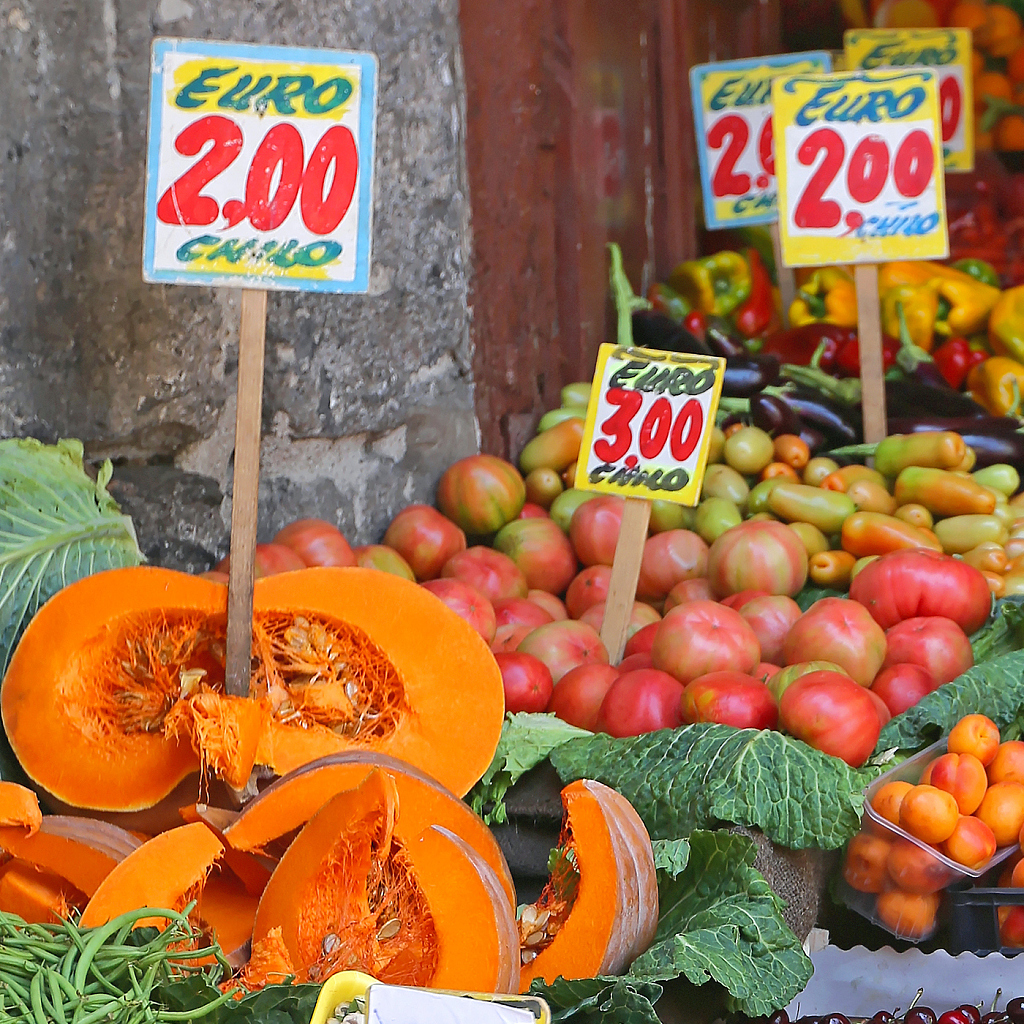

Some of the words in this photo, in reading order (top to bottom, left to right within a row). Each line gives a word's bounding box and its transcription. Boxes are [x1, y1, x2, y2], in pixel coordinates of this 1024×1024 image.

[175, 65, 353, 115] EURO
[710, 76, 771, 110] EU
[795, 82, 927, 126] EURO
[609, 360, 716, 396] EURO
